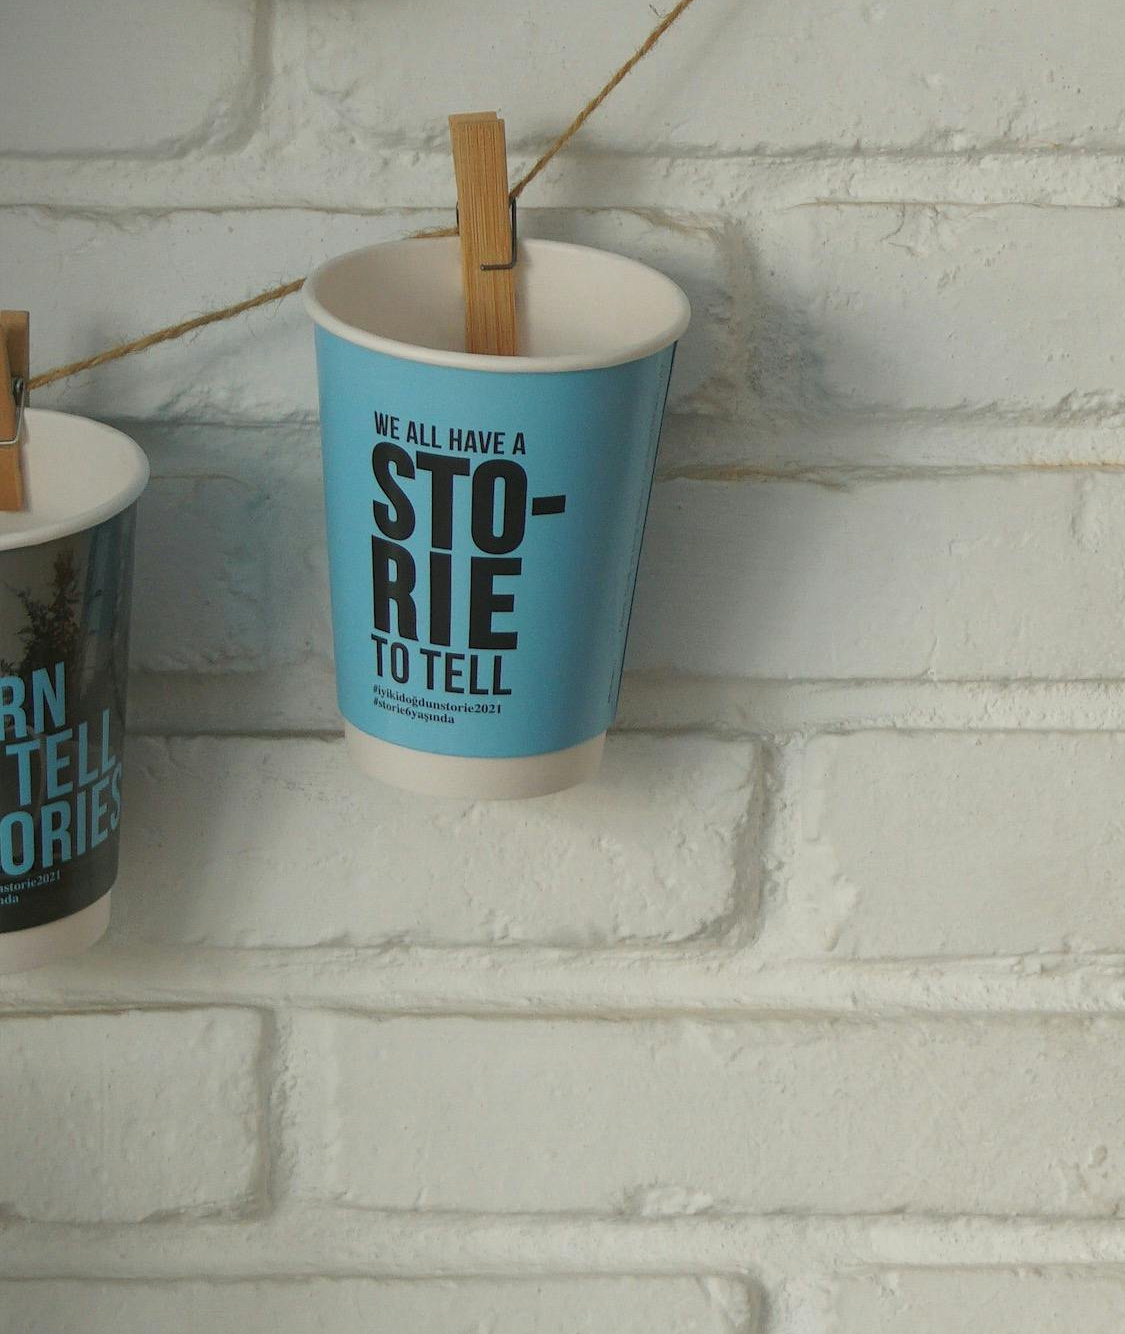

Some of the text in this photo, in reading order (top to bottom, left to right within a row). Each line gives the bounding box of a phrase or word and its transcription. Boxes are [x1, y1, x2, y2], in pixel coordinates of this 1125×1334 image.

[374, 411, 527, 455] WE ALL HAVE A
[371, 441, 567, 555] STO-
[371, 534, 523, 650] RIE
[371, 633, 512, 696] TO TELL
[373, 683, 502, 715] #iyikidoğdunstorie2021
[6, 708, 117, 806] TELL
